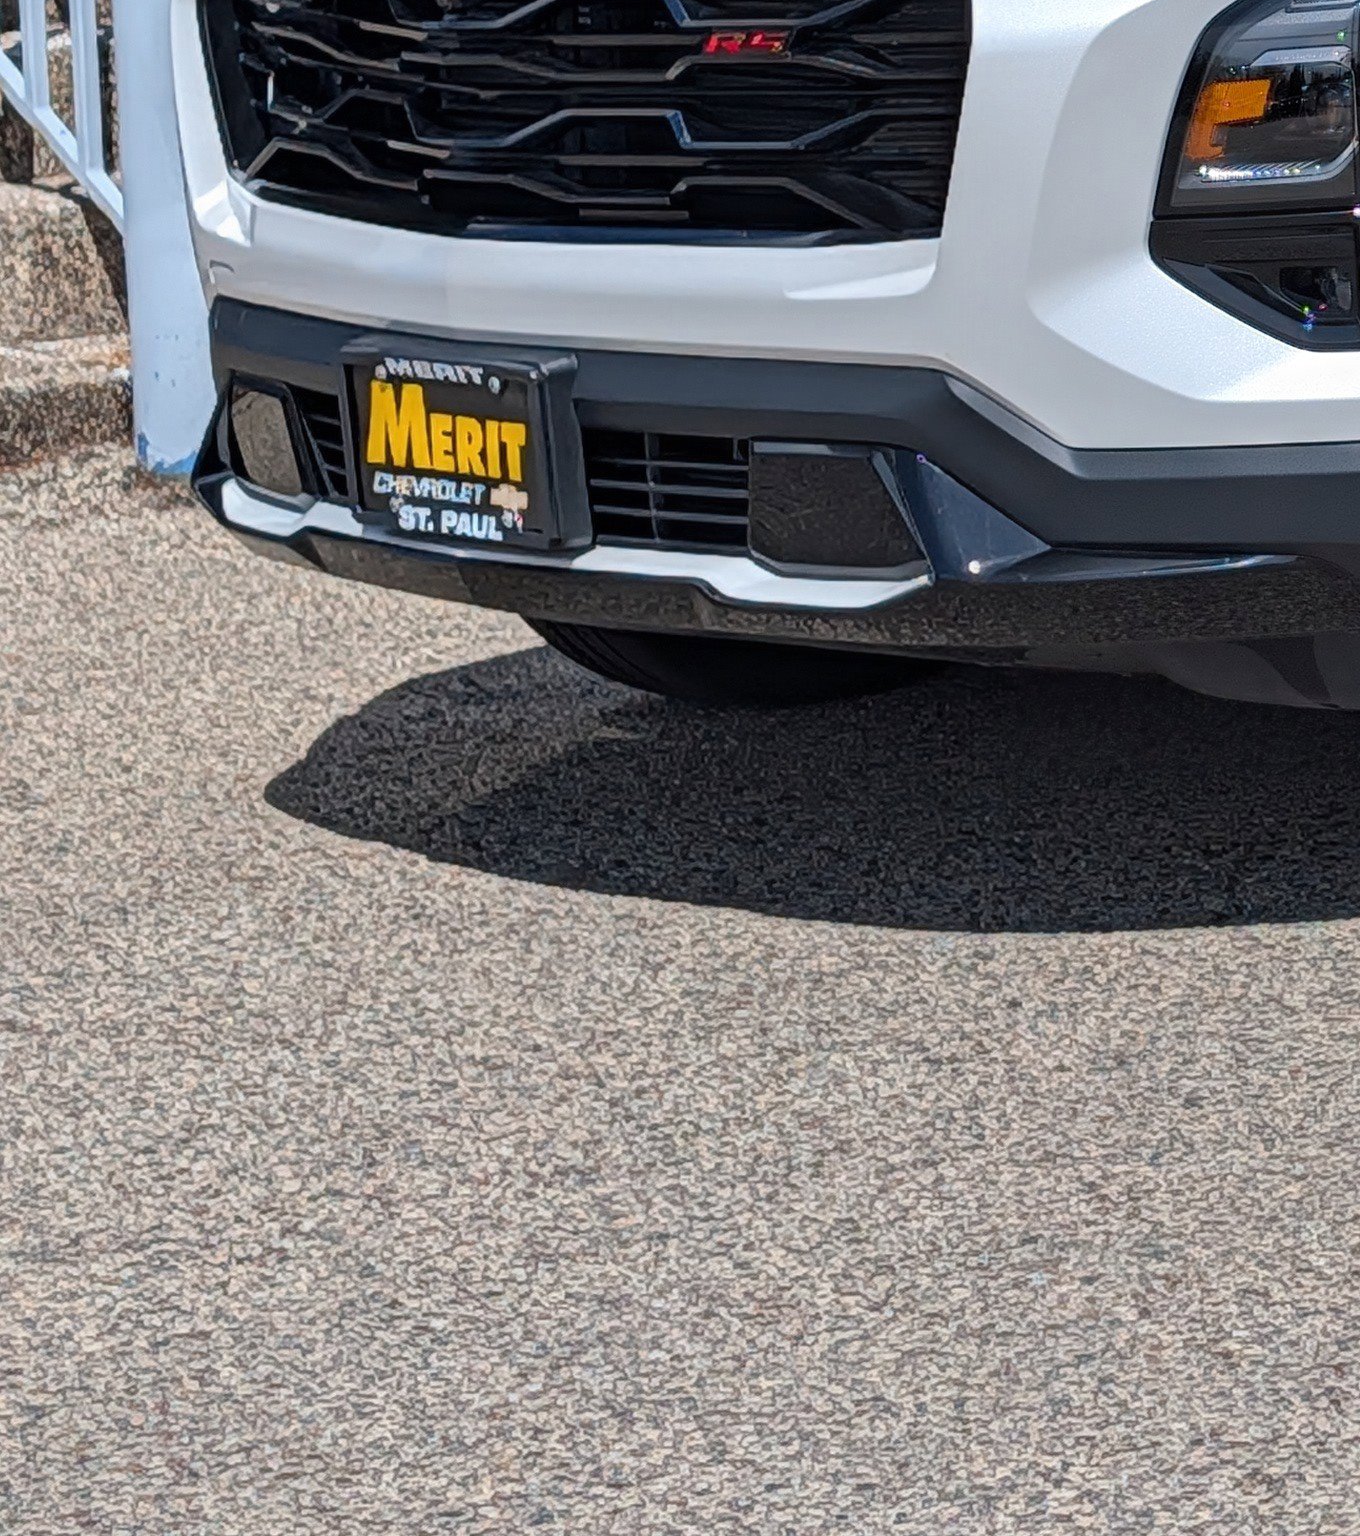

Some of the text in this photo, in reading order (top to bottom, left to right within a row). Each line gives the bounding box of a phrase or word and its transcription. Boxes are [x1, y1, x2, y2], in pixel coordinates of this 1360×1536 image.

[704, 31, 785, 54] RS
[398, 504, 503, 542] ST. PAUL
